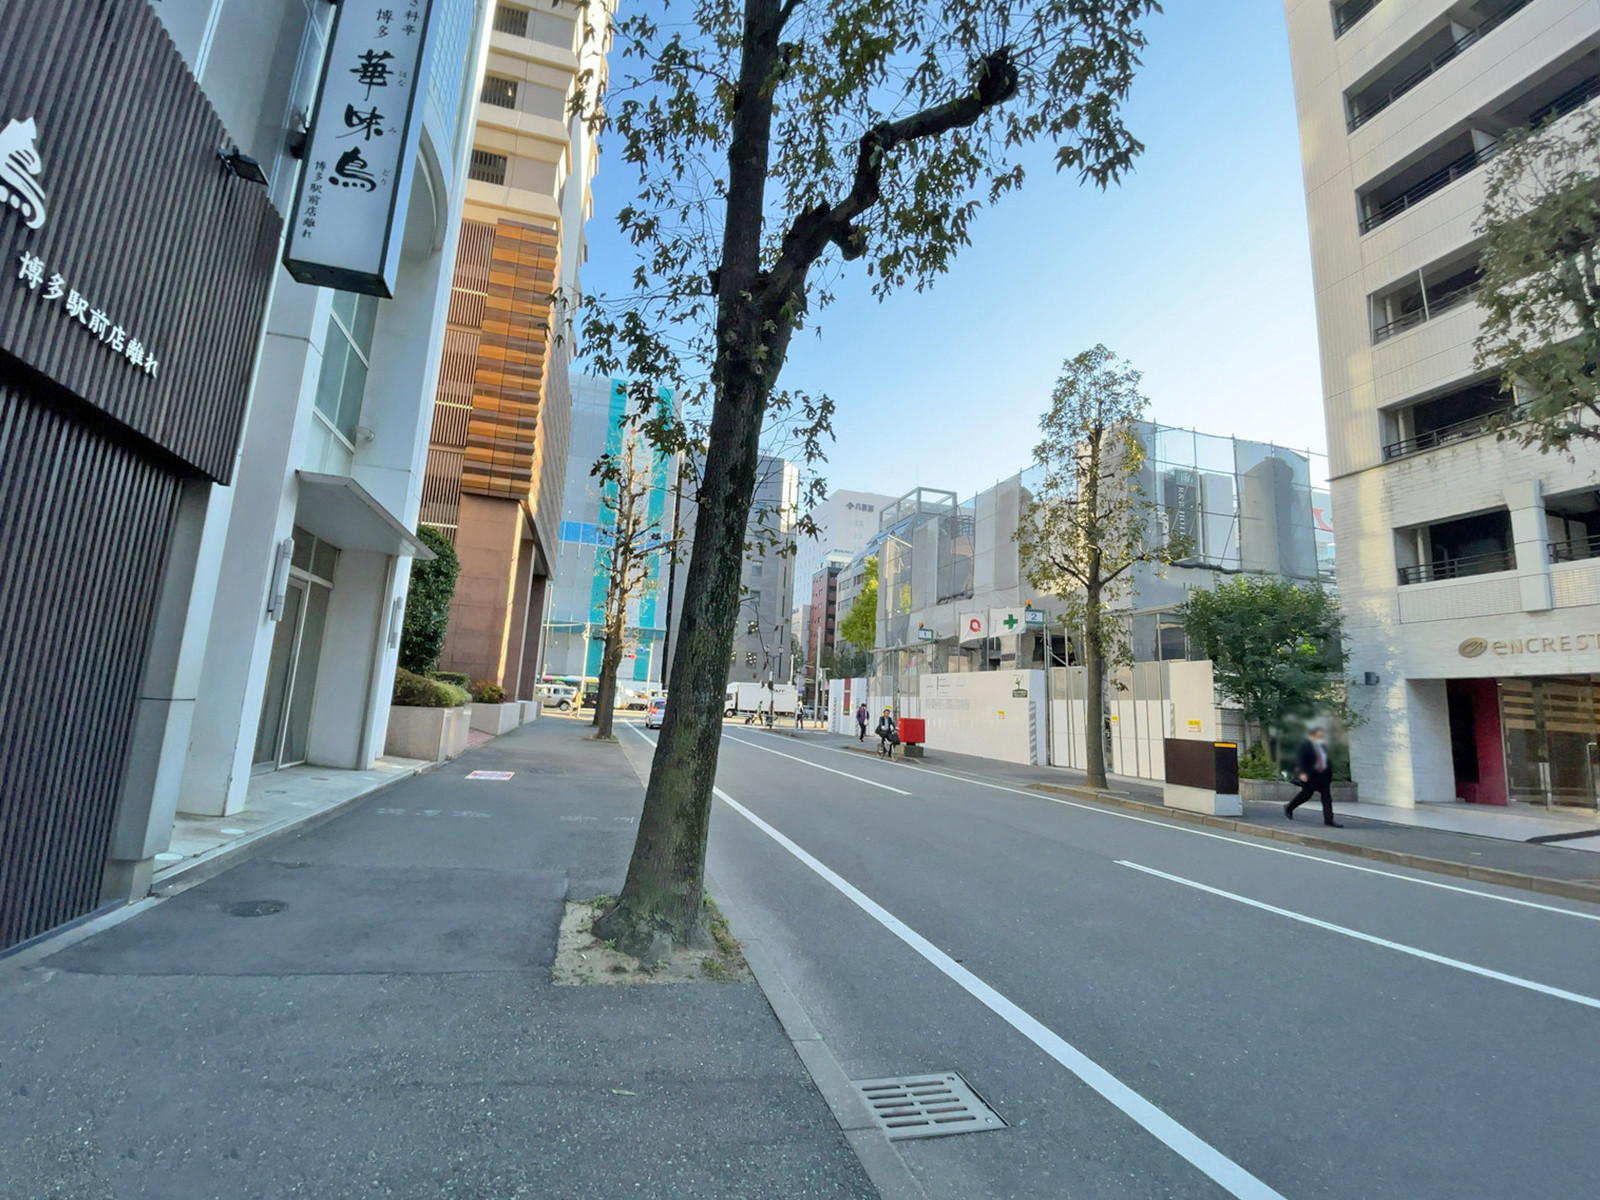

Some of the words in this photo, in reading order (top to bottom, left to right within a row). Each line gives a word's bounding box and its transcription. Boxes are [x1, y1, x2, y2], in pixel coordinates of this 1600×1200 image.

[374, 8, 394, 39] 博多
[302, 160, 327, 239] 博多駅前店離れ
[18, 251, 158, 378] 博多駅前店離れ
[1031, 613, 1038, 621] 2
